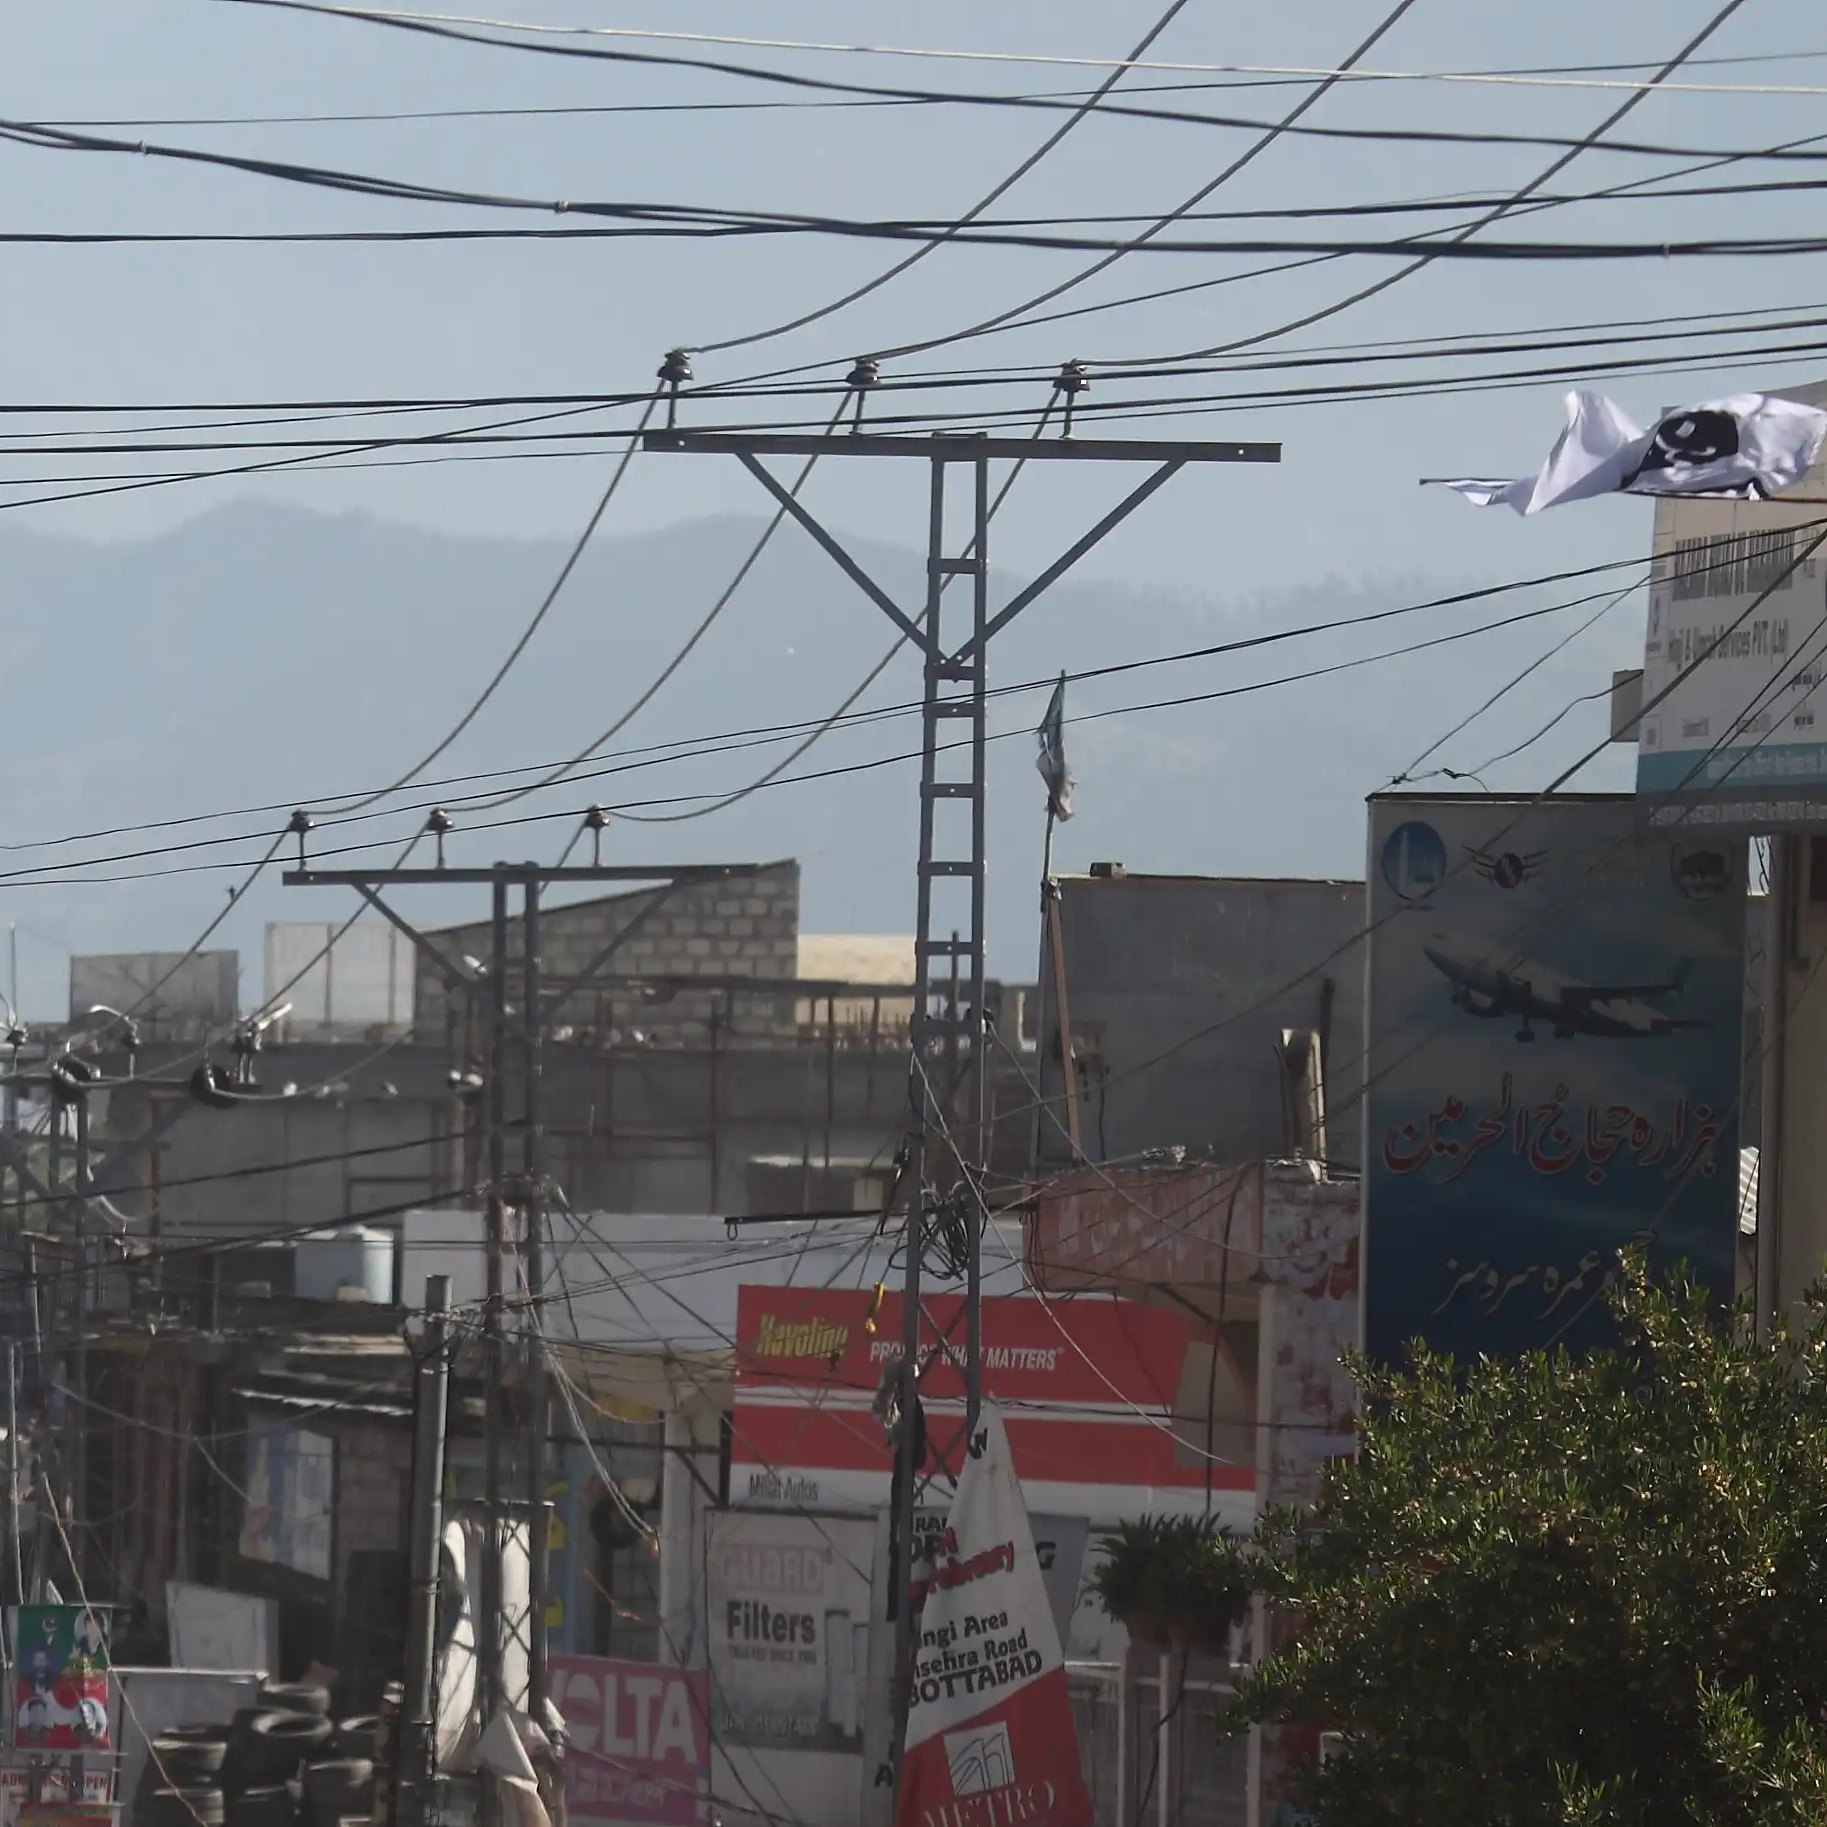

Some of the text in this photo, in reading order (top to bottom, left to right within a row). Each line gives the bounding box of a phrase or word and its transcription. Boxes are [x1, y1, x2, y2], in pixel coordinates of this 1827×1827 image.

[756, 1314, 848, 1358] Havoline
[784, 1475, 819, 1501] Autos
[726, 1599, 817, 1645] Filters
[921, 1609, 1008, 1651] ngi Area
[984, 1627, 1029, 1655] Road
